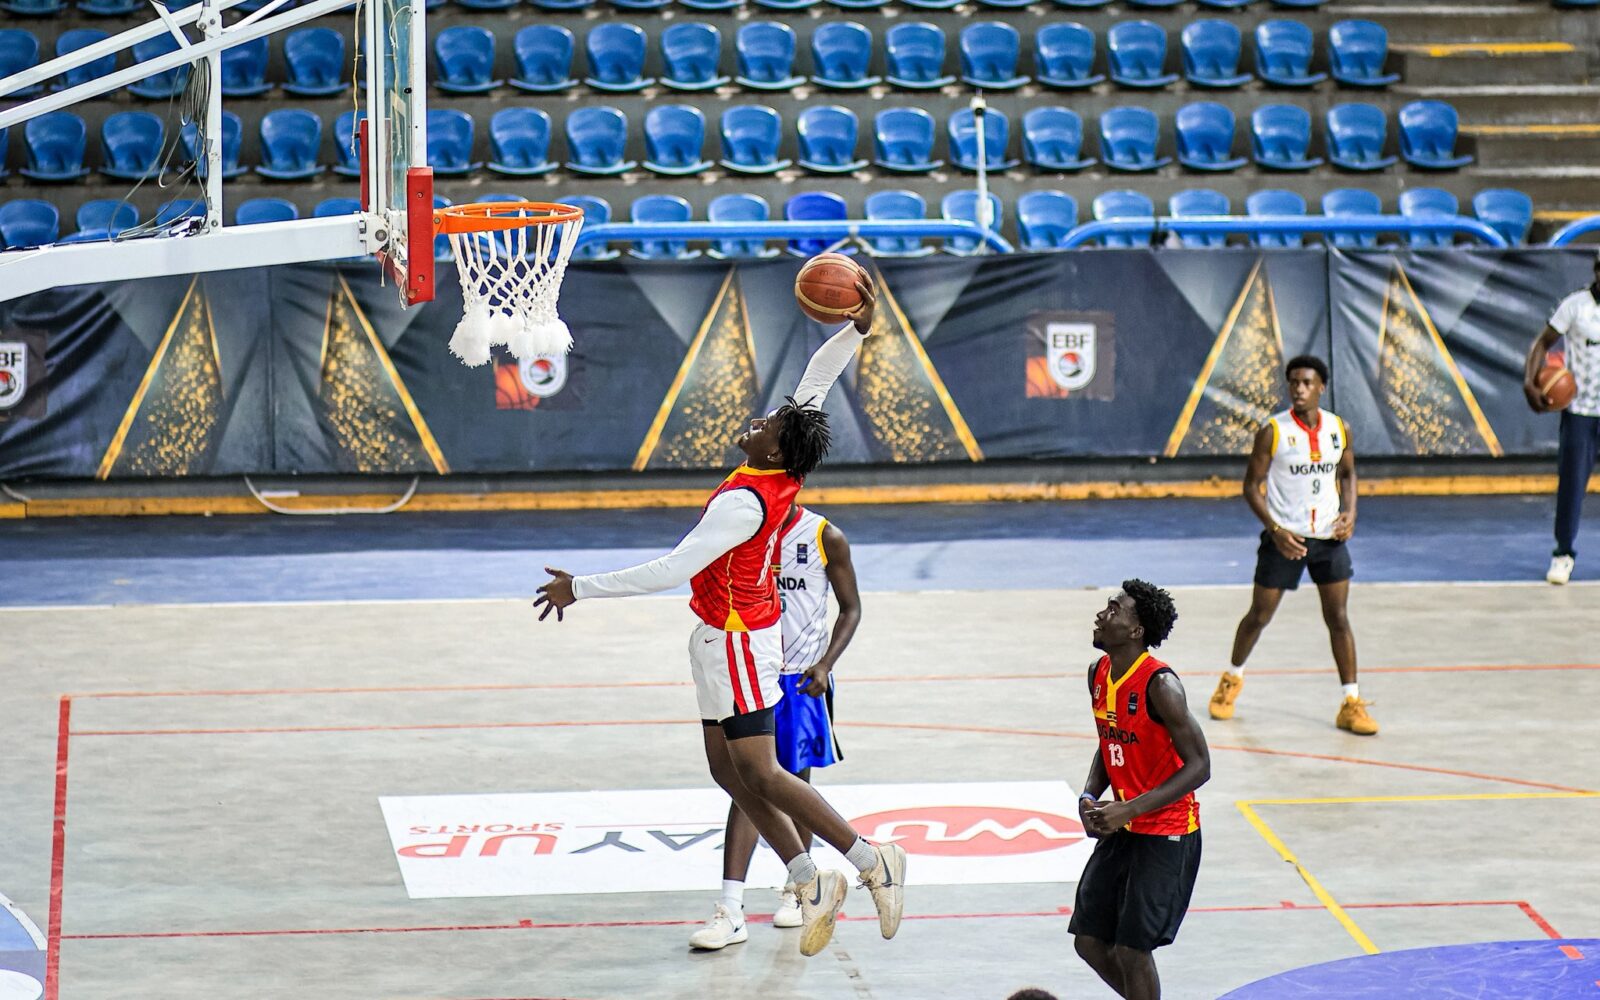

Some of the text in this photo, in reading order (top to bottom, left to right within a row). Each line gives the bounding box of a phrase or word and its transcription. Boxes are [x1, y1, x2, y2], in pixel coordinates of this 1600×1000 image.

[1052, 334, 1090, 349] EBF
[0, 352, 22, 367] BF
[1312, 479, 1321, 495] 9
[776, 576, 807, 591] NDA
[797, 736, 826, 760] 20
[1108, 743, 1125, 767] 13
[408, 822, 566, 836] SPORTS
[397, 833, 558, 859] UP
